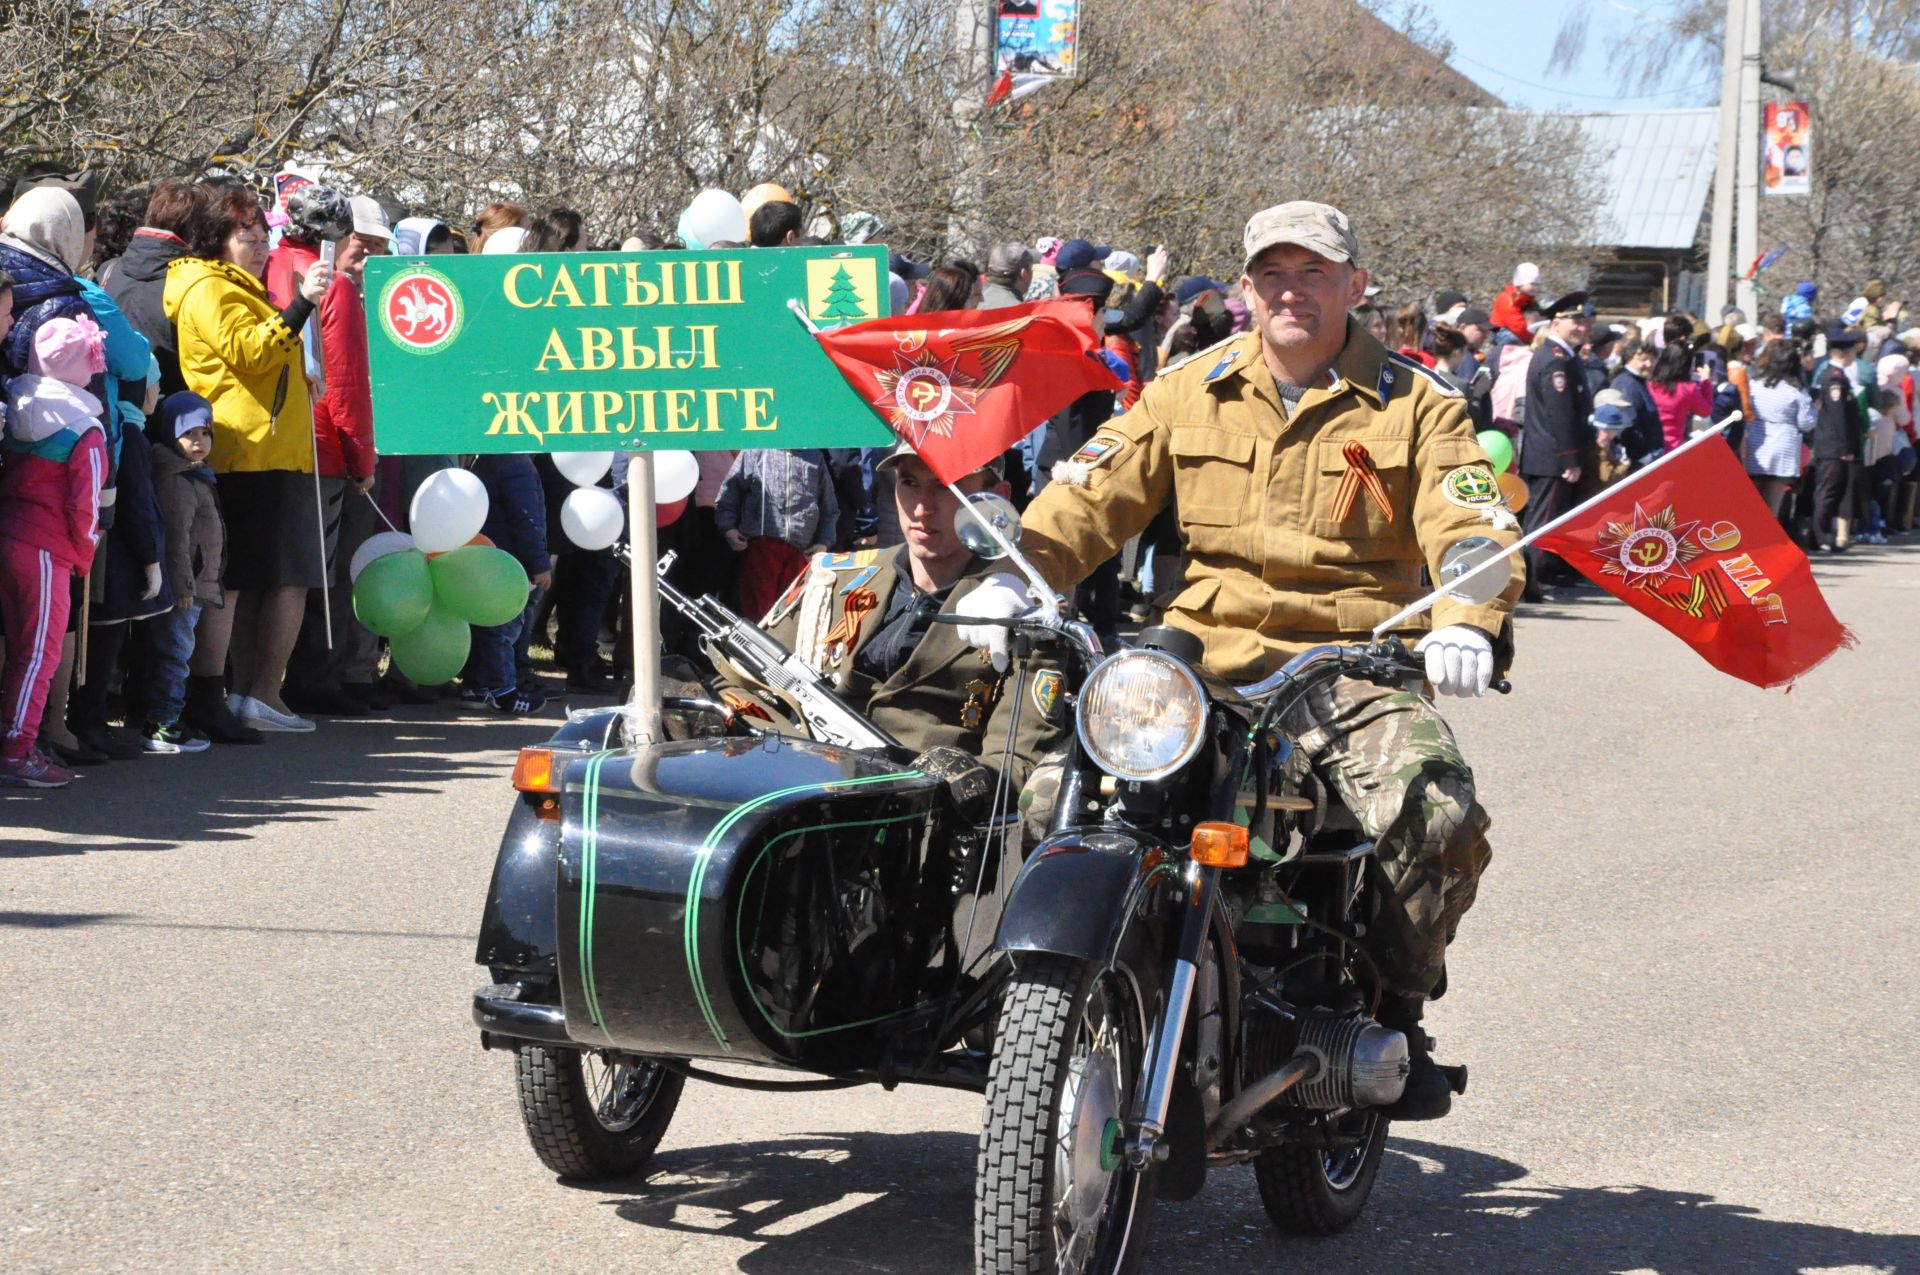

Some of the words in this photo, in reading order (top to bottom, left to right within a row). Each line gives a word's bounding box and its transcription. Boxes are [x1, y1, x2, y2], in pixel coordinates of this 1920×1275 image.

[502, 260, 745, 309] САТЫШ
[534, 325, 721, 372] АВЫЛ
[482, 388, 779, 446] ҖИРЛЕГЕ
[1622, 528, 1674, 560] ОТЕЧЕСТВЕННАЯ
[1697, 520, 1741, 552] 9
[1717, 552, 1788, 627] МАЯ
